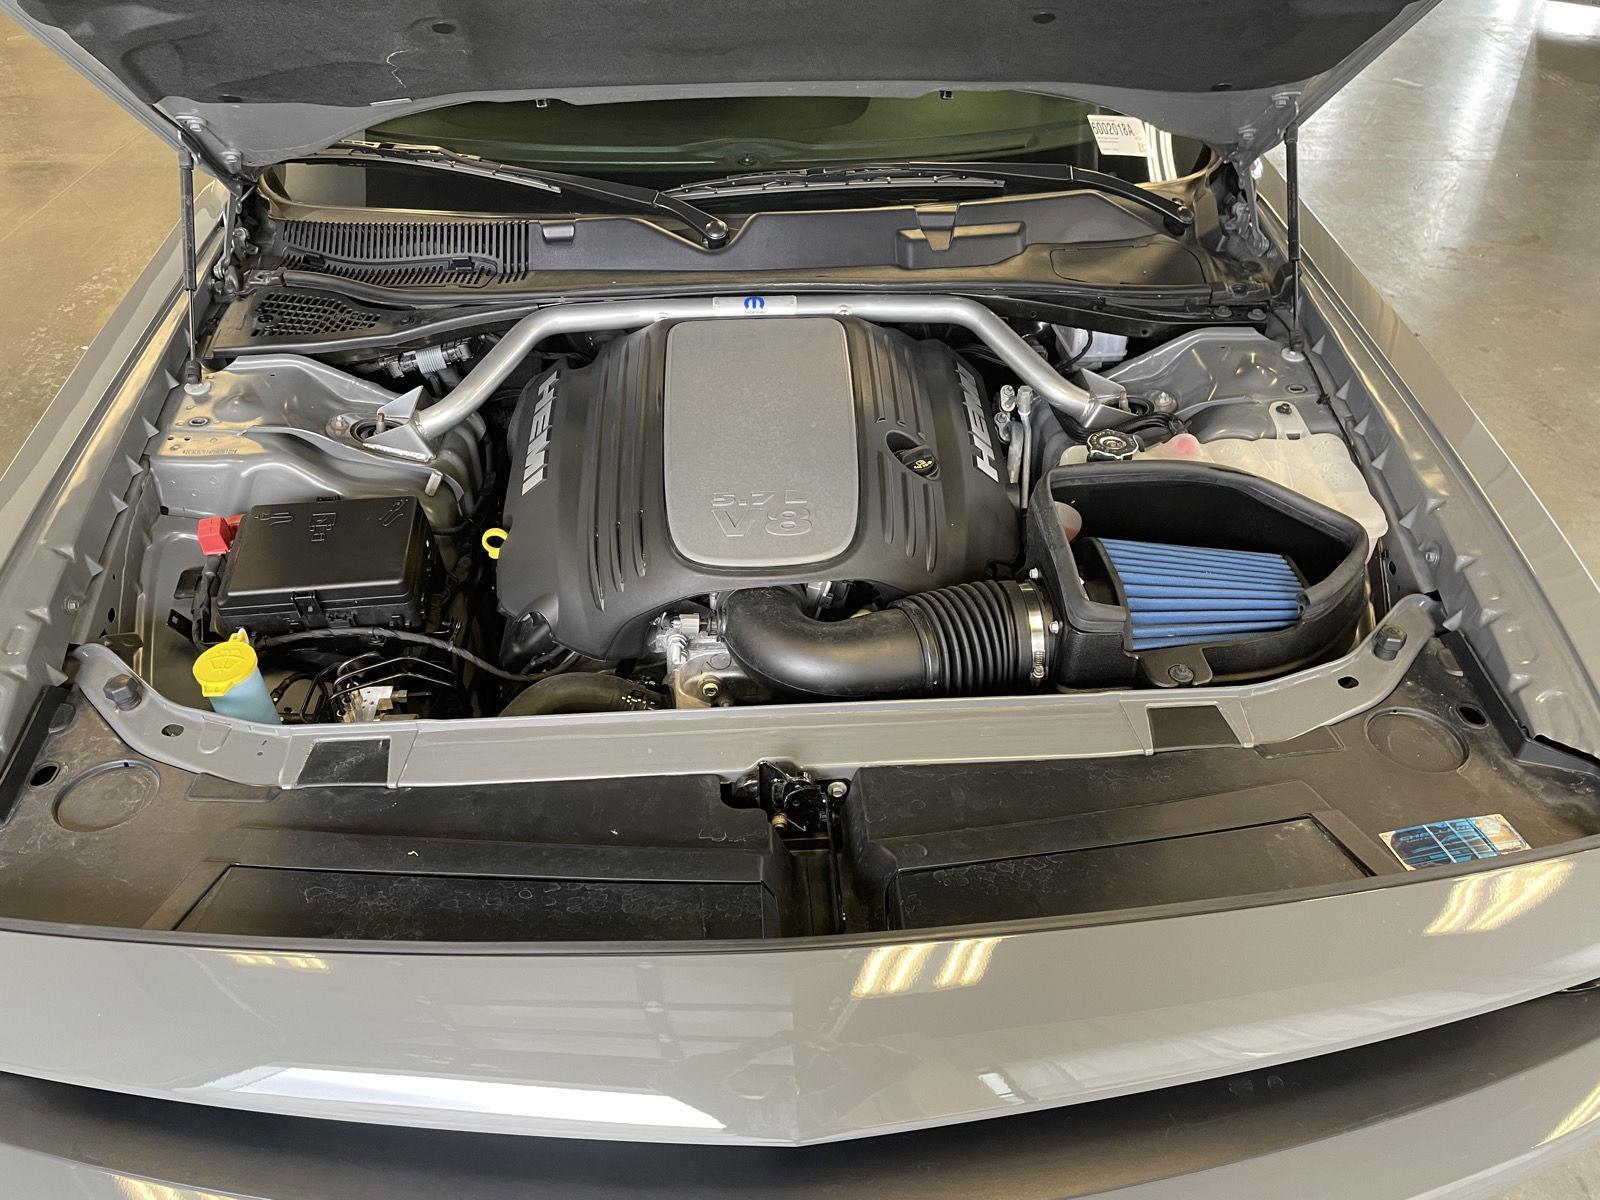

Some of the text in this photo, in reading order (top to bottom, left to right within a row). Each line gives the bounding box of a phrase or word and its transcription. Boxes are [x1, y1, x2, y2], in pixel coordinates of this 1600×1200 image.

[521, 370, 560, 497] HEMI
[955, 360, 999, 483] HEMI
[710, 506, 813, 537] V8
